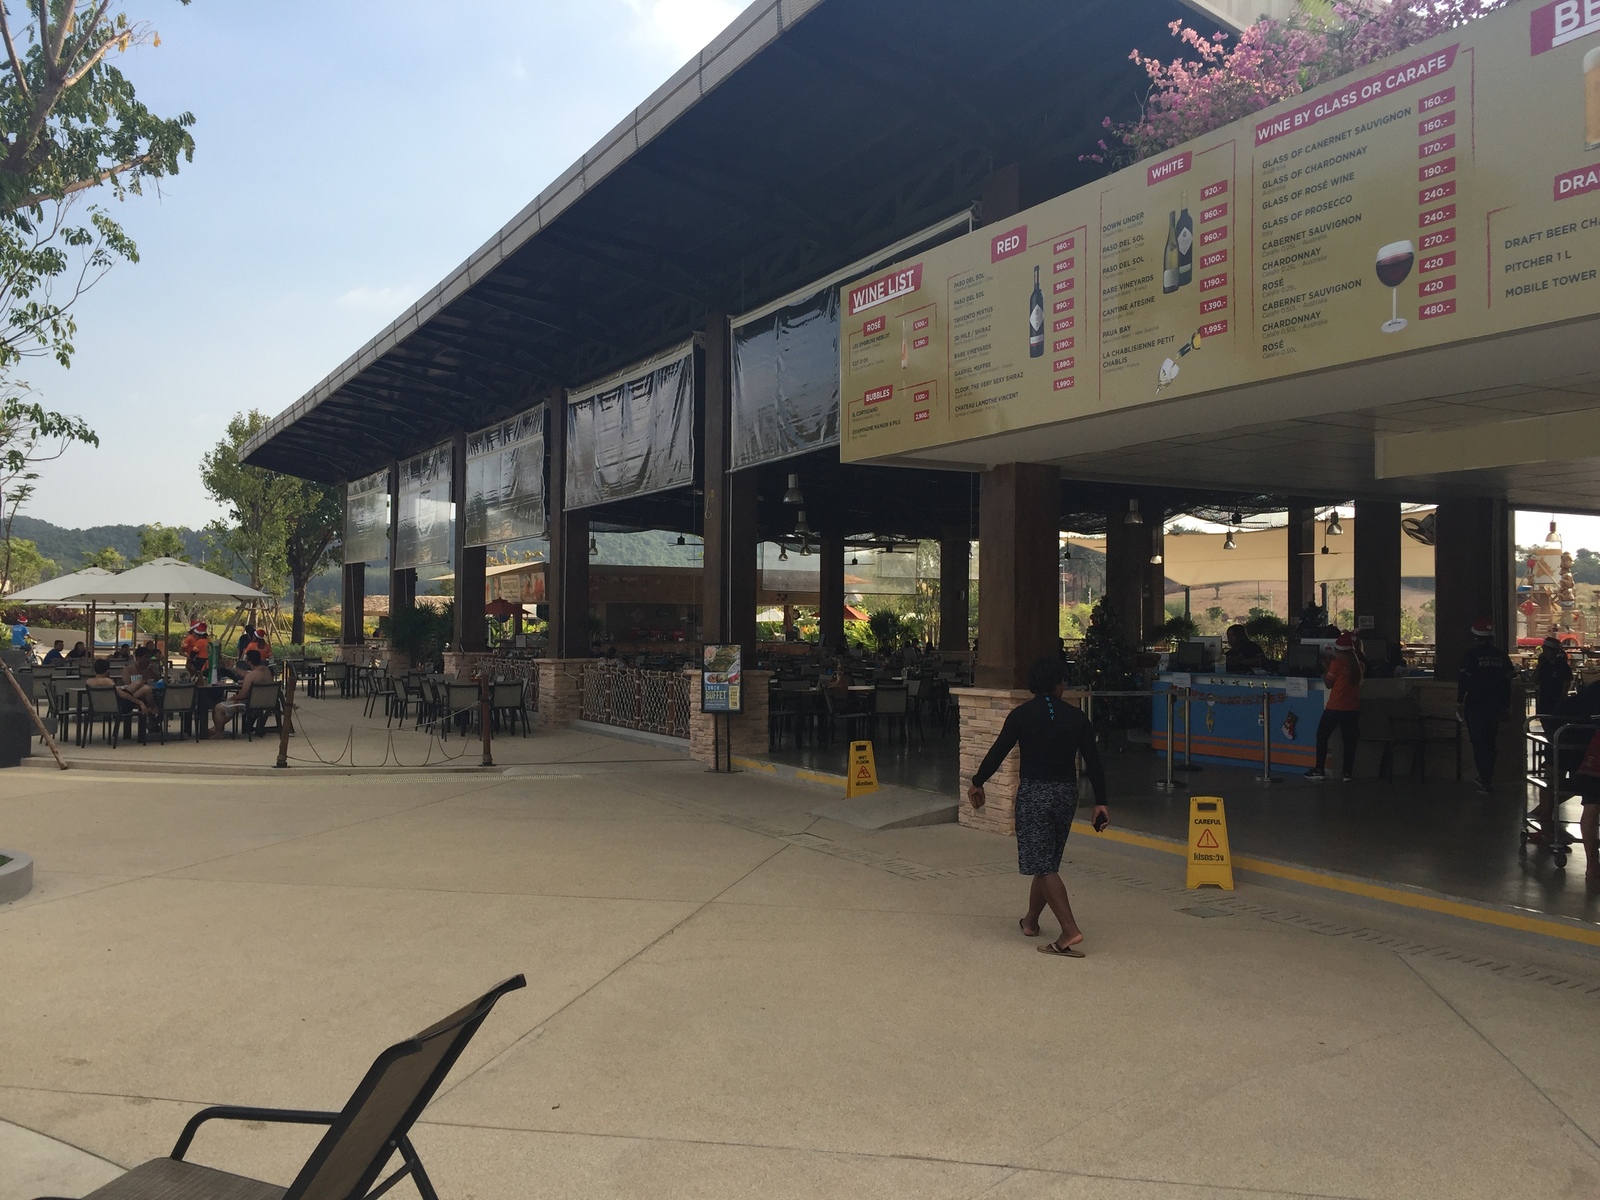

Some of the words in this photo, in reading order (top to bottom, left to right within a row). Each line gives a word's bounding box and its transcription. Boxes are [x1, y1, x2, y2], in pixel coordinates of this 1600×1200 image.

[1258, 118, 1290, 140] WINE
[1294, 110, 1310, 126] BY
[1314, 91, 1357, 117] GLASS
[1361, 82, 1382, 98] OR
[1386, 54, 1446, 88] CARAFE
[1424, 96, 1448, 108] 160.-
[1424, 119, 1448, 132] 160.-
[1262, 153, 1289, 169] GLASS
[1291, 148, 1303, 159] OF
[1305, 129, 1352, 154] CANERNET
[1355, 107, 1411, 135] SAUVIGNON
[1424, 142, 1447, 155] 170.-
[1152, 158, 1184, 180] WHITE
[1262, 174, 1289, 189] GLASS
[1291, 169, 1303, 180] OF
[1305, 146, 1368, 174] CHARDONNAY
[1424, 166, 1448, 178] 190.-
[1559, 171, 1600, 194] DRA
[1204, 186, 1222, 197] 920.-
[1262, 194, 1289, 210] GLASS
[1291, 190, 1303, 200] OF
[1305, 180, 1328, 196] ROSÉ
[1330, 172, 1355, 187] WINE
[1424, 188, 1450, 201] 240.-
[1204, 210, 1222, 220] 960.-
[1262, 215, 1289, 230] GLASS
[1291, 210, 1303, 221] OF
[1305, 194, 1352, 216] PROSECCO
[1424, 210, 1450, 224] 240.-
[1102, 220, 1122, 232] DOWN
[1122, 211, 1144, 224] UNDER
[1204, 232, 1222, 243] 960.-
[1262, 230, 1306, 250] CABERNET
[1308, 213, 1362, 236] SAUVIGNON
[1505, 232, 1543, 249] DRAFT
[1546, 222, 1577, 239] BEER
[996, 235, 1020, 254] RED
[1102, 243, 1118, 254] PASO
[1119, 239, 1131, 248] DEL
[1132, 234, 1144, 245] SOL
[1424, 234, 1449, 248] 270.-
[1102, 264, 1118, 274] PASO
[1119, 260, 1131, 270] DEL
[1132, 256, 1144, 266] SOL
[1204, 254, 1225, 266] 1,100.-
[1262, 247, 1322, 271] CHARDONNAY
[1424, 257, 1443, 270] 420
[1505, 254, 1553, 274] PITCHER
[1556, 252, 1562, 261] 1
[1565, 250, 1572, 260] L
[966, 276, 975, 285] DEL
[976, 273, 985, 282] SOL
[1102, 286, 1118, 296] RARE
[1119, 274, 1154, 290] VINEYARDS
[1204, 278, 1224, 288] 1,190.-
[1262, 277, 1284, 291] ROSÉ
[1424, 280, 1443, 292] 420
[1505, 280, 1549, 298] MOBILE
[1552, 269, 1597, 287] TOWER
[853, 282, 884, 308] WINE
[888, 269, 914, 294] LIST
[1262, 294, 1306, 312] CABERNET
[1308, 278, 1362, 300] SAUVIGNON
[966, 294, 975, 302] DEL
[976, 291, 985, 300] SOL
[1102, 304, 1128, 317] CANTINE
[1130, 296, 1156, 310] ATESINE
[1204, 300, 1226, 312] 1,390.-
[1424, 304, 1450, 316] 480.-
[866, 318, 881, 332] ROSÉ
[1056, 322, 1072, 330] 1,100.-
[1262, 310, 1322, 332] CHARDONNAY
[974, 325, 992, 335] SHIRAZ
[1102, 328, 1118, 338] PAUA
[1119, 325, 1132, 334] BAY
[1204, 324, 1226, 334] 1,995.-
[954, 351, 966, 359] RARE
[966, 344, 992, 355] VINEYARDS
[1102, 352, 1110, 360] LA
[1111, 341, 1156, 356] CHABLISIENNE
[1156, 335, 1175, 346] PETIT
[1262, 339, 1284, 352] ROSÉ
[1102, 356, 1128, 368] CHABLIS
[954, 368, 972, 376] GABRIEL
[971, 382, 980, 390] THE
[980, 379, 992, 388] VERY
[993, 376, 1006, 385] SEXY
[1006, 372, 1024, 382] SHIRAZ
[866, 388, 890, 402] BUBBLES
[955, 403, 976, 412] CHATEAU
[976, 398, 998, 407] LAMOTHE
[998, 392, 1019, 402] VINCENT
[706, 691, 726, 700] BUFFET
